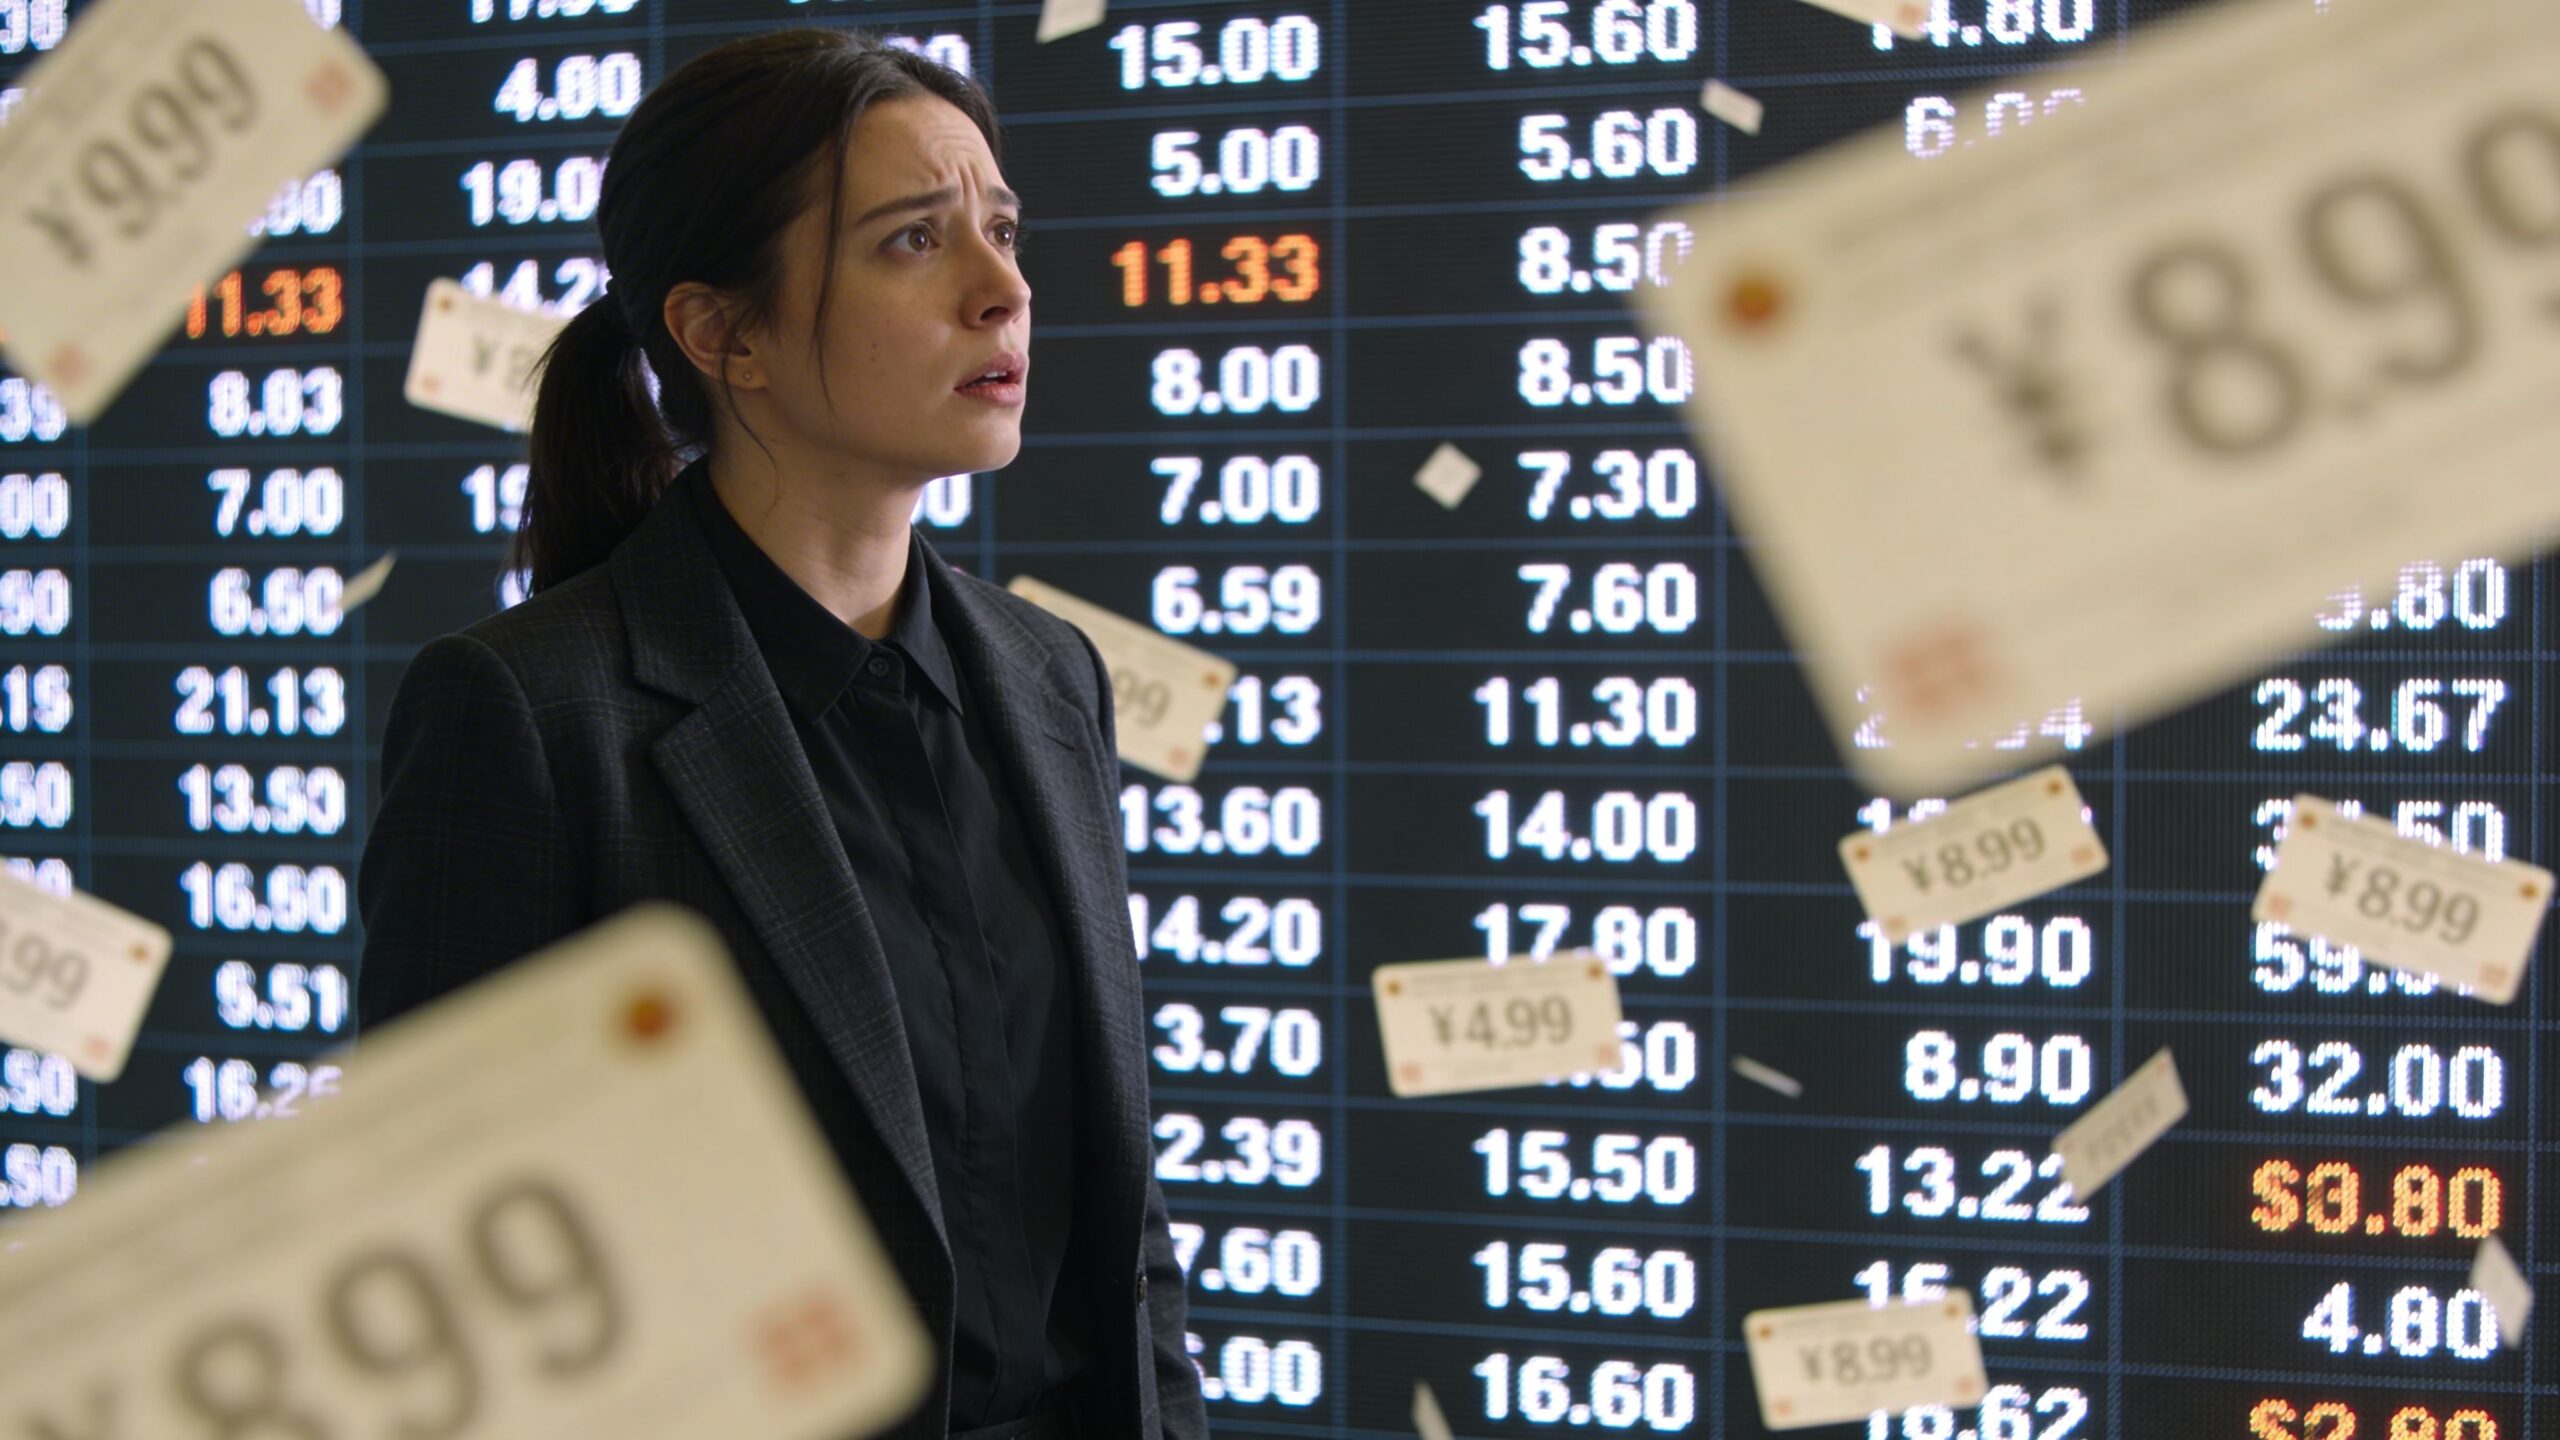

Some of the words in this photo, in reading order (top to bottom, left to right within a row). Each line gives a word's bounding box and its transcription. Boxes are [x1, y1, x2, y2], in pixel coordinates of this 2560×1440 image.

[1110, 17, 1319, 89] 15.00
[1475, 0, 1697, 69] 15.60
[495, 52, 641, 121] 4.80
[1152, 126, 1319, 196] 5.00
[1520, 108, 1697, 180] 5.60
[462, 156, 610, 226] 19.0
[1114, 235, 1319, 305] 11.33
[1519, 222, 1694, 293] 8.50
[187, 268, 342, 338] 11.33
[209, 368, 342, 436] 8.03
[1152, 345, 1319, 414] 8.00
[1519, 335, 1694, 406] 8.50
[209, 468, 343, 535] 7.00
[1152, 456, 1319, 524] 7.00
[1519, 449, 1696, 519] 7.30
[1153, 566, 1320, 633] 6.59
[1519, 563, 1696, 633] 7.60
[176, 667, 344, 734] 21.13
[1476, 677, 1696, 746] 11.30
[1119, 784, 1321, 855] 13.60
[1476, 791, 1696, 861] 14.00
[2325, 849, 2480, 945] ¥8.99
[1857, 914, 2091, 986] 19.90
[1154, 1004, 1320, 1076] 3.70
[1428, 993, 1574, 1050] ¥4.99
[1905, 1031, 2090, 1104] 8.90
[2253, 1040, 2502, 1118] 32.00
[1155, 1114, 1321, 1187] 2.39
[1475, 1129, 1695, 1204] 15.50
[1855, 1146, 2089, 1222] 13.22
[1475, 1241, 1695, 1318] 15.60
[2302, 1281, 2499, 1359] 4.80
[1185, 1333, 1321, 1405] .00
[1475, 1353, 1694, 1431] 16.60
